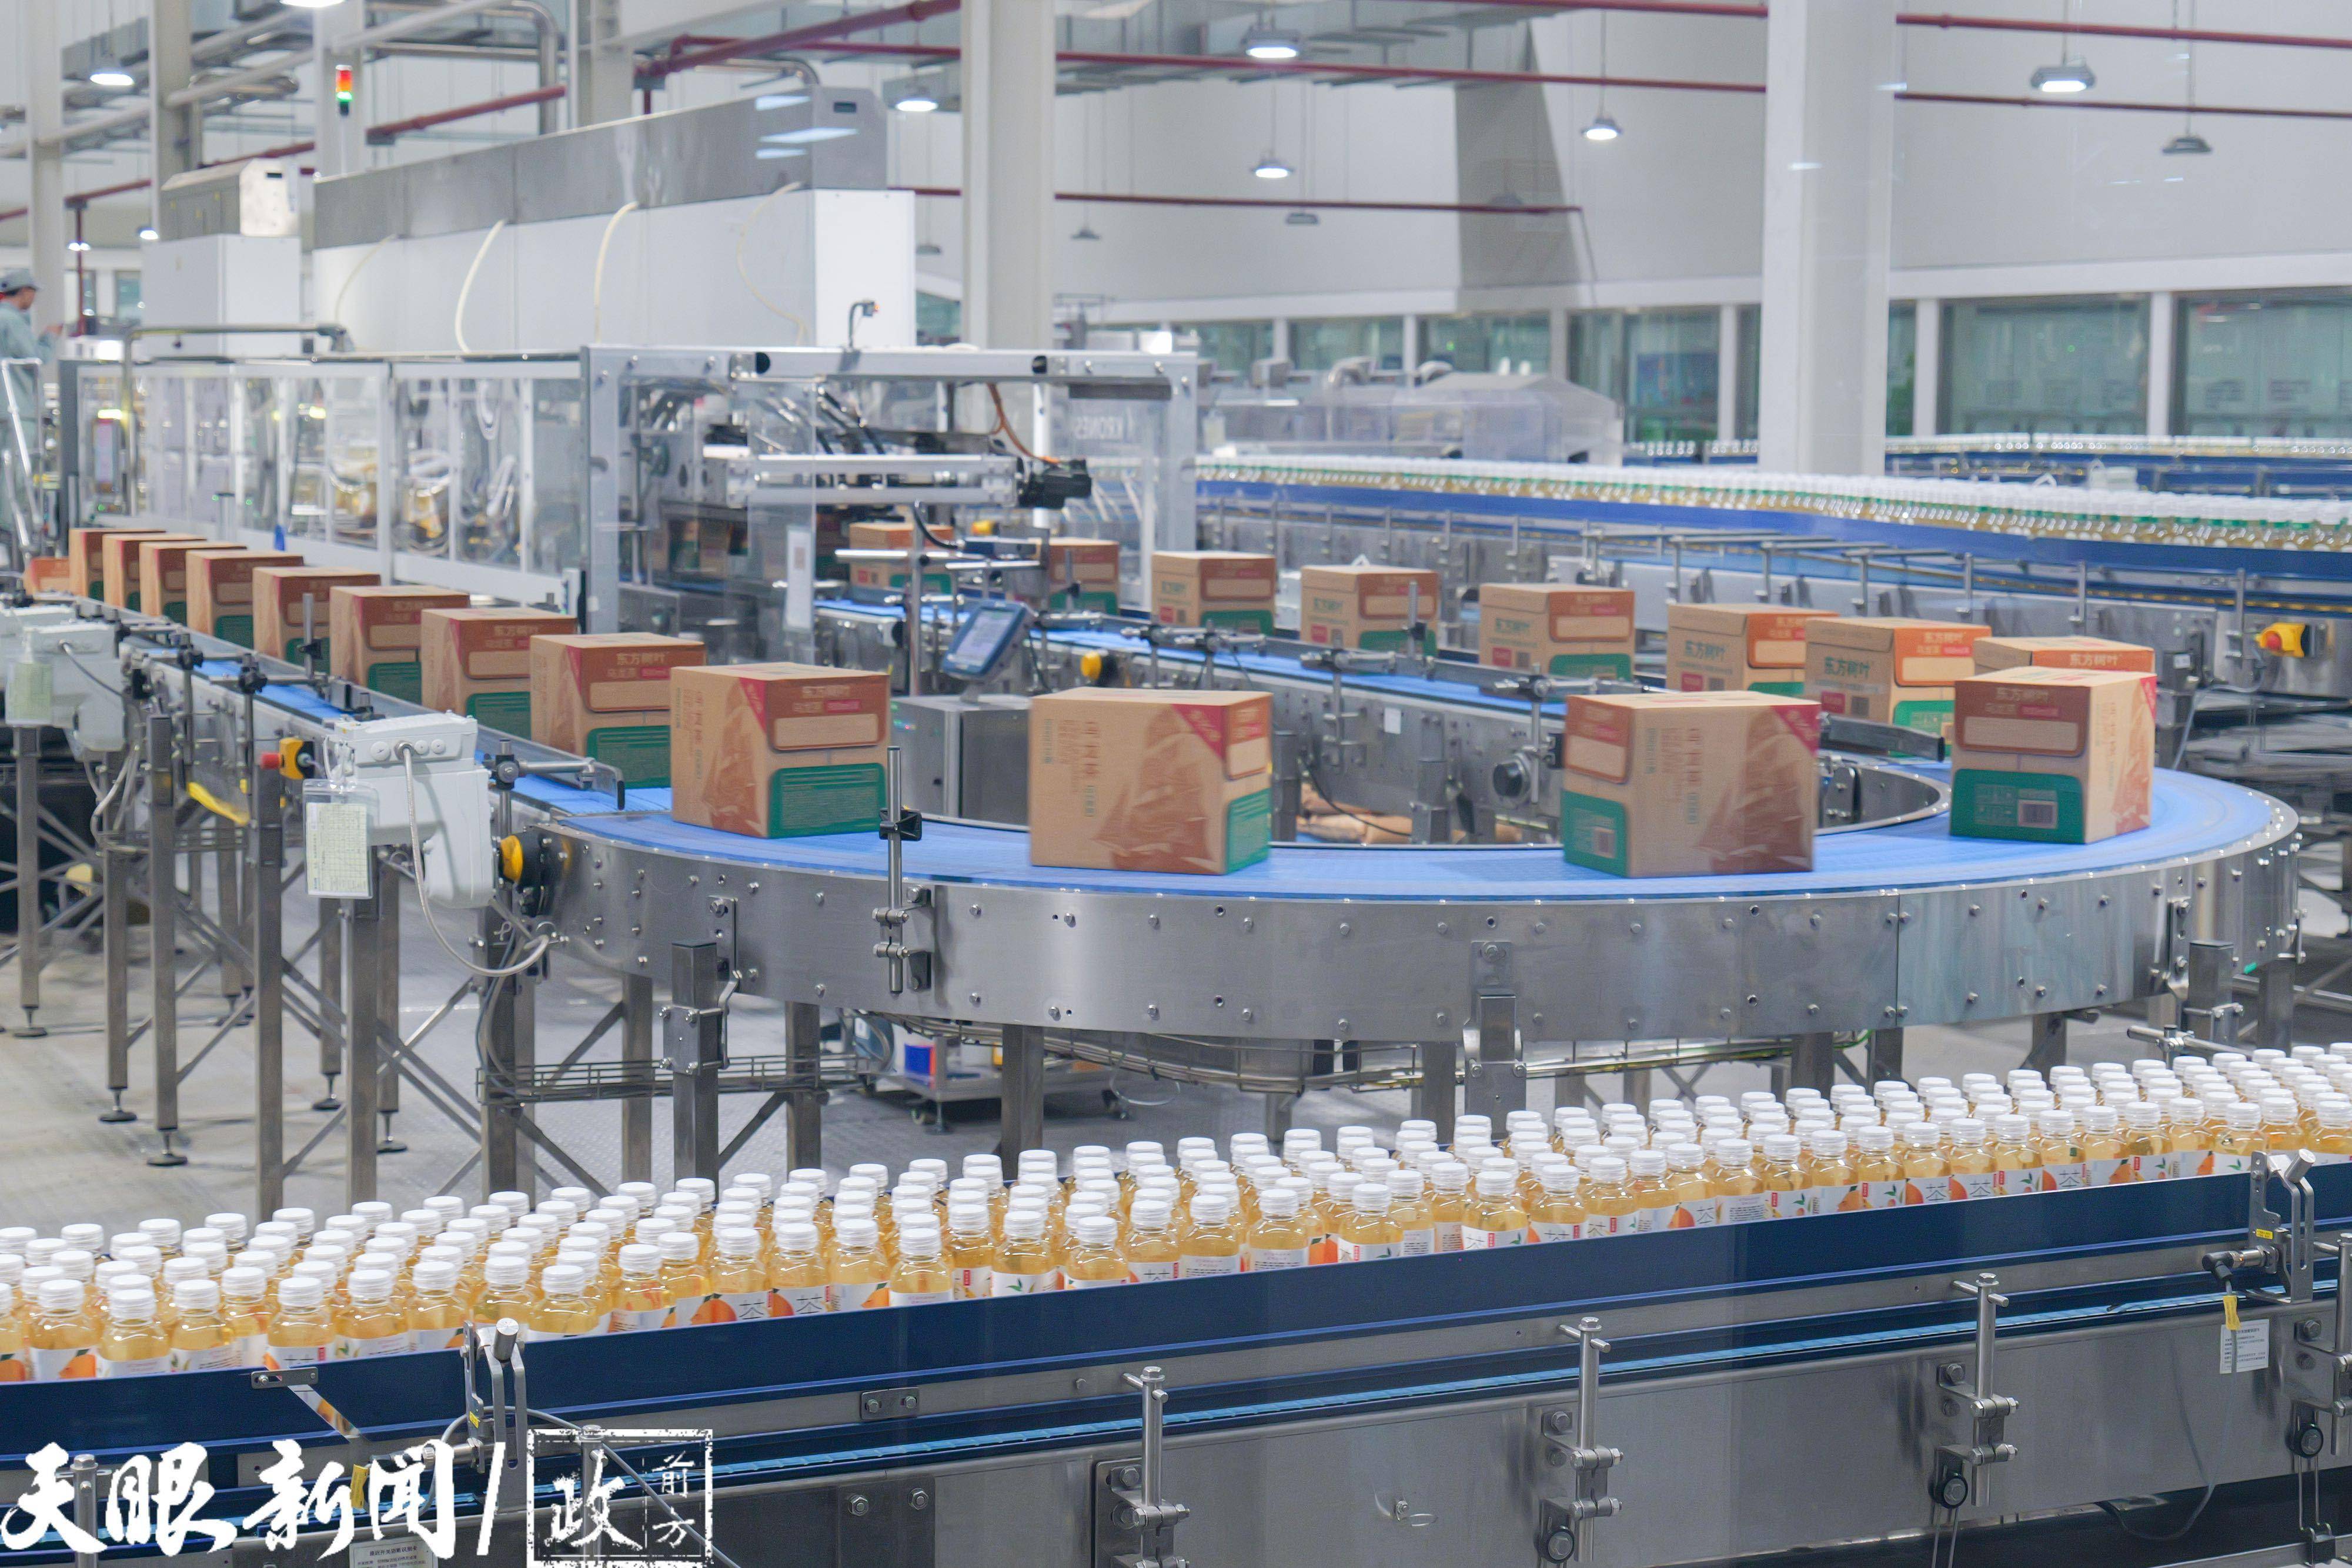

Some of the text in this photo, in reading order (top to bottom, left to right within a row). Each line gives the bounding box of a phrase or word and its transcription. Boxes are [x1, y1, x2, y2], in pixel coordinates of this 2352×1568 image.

[1825, 656, 1870, 678] 东方树叶
[2070, 653, 2117, 667] 东方树叶
